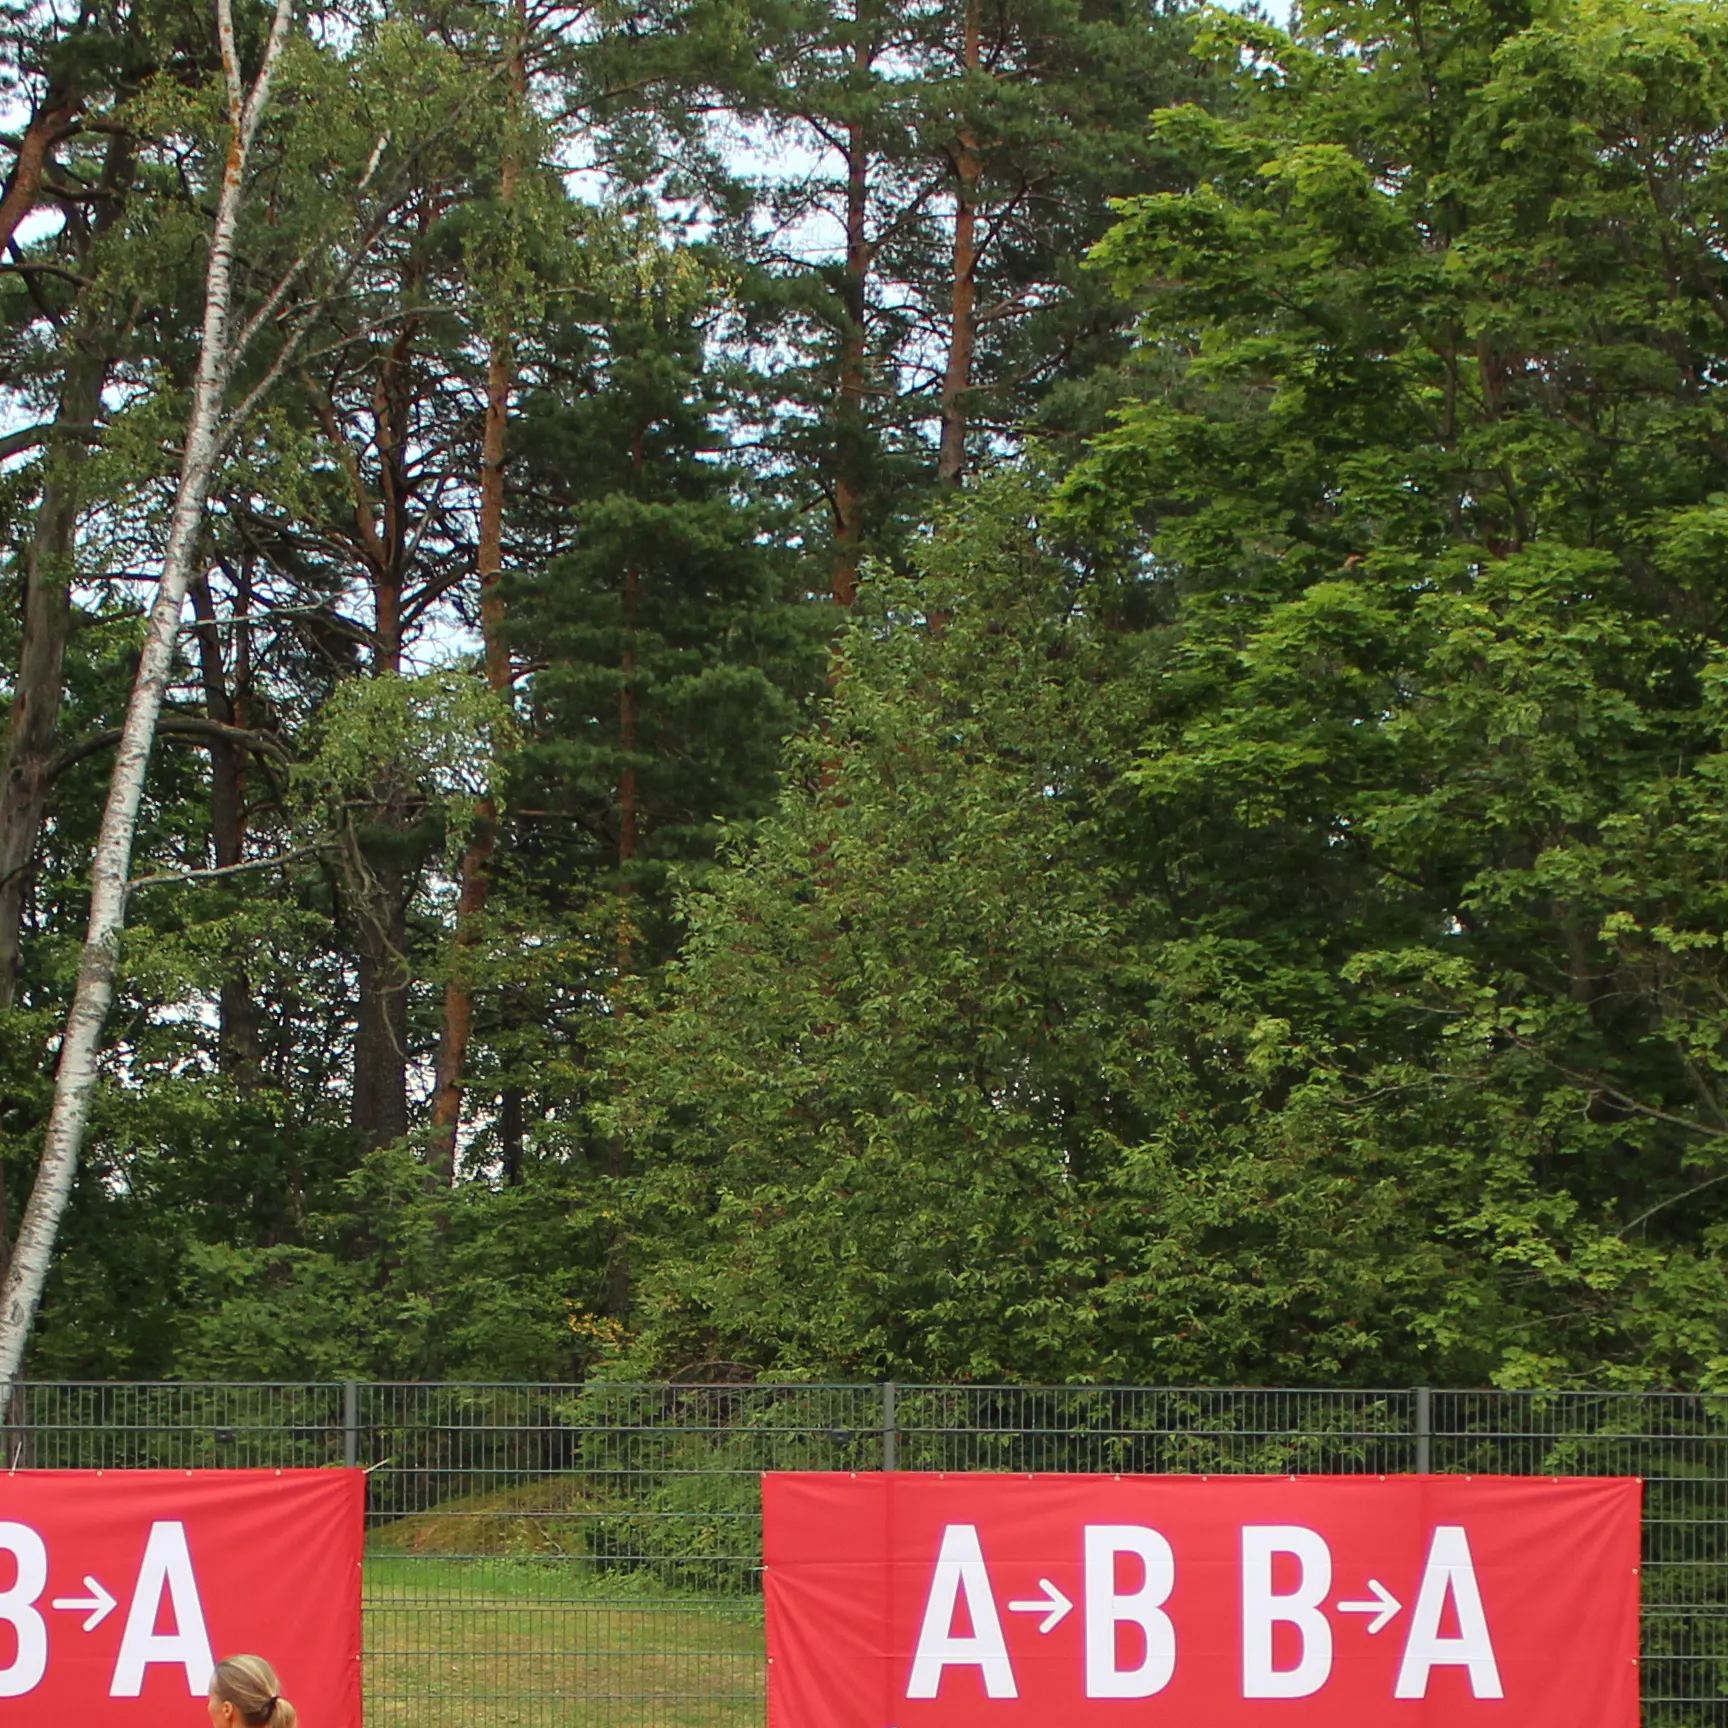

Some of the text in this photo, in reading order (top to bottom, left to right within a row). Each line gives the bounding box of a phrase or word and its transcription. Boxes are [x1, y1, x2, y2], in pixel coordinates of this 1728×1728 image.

[109, 1521, 214, 1697] A
[905, 1524, 1504, 1699] A B B A
